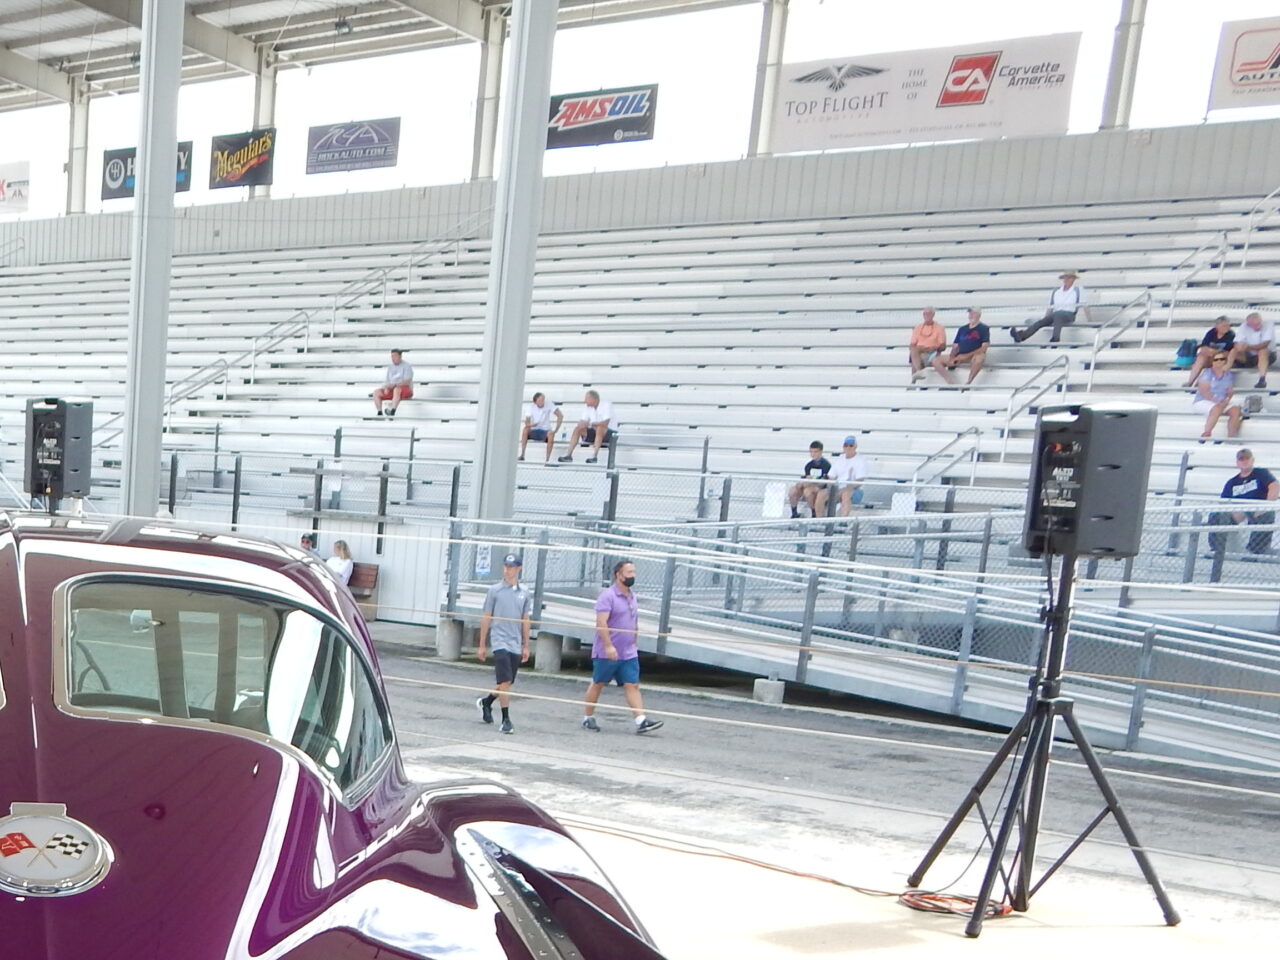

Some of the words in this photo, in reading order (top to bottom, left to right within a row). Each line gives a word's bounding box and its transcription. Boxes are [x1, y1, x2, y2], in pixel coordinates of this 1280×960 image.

[908, 68, 924, 76] THE
[998, 61, 1061, 78] Corvette
[1239, 72, 1280, 81] AUT
[901, 80, 927, 89] HOME
[945, 68, 989, 93] CA
[1007, 72, 1066, 88] America
[552, 92, 648, 128] AMSOIL
[785, 100, 818, 117] TOP
[822, 91, 888, 113] FLIGHT
[213, 131, 274, 182] Meguiar's
